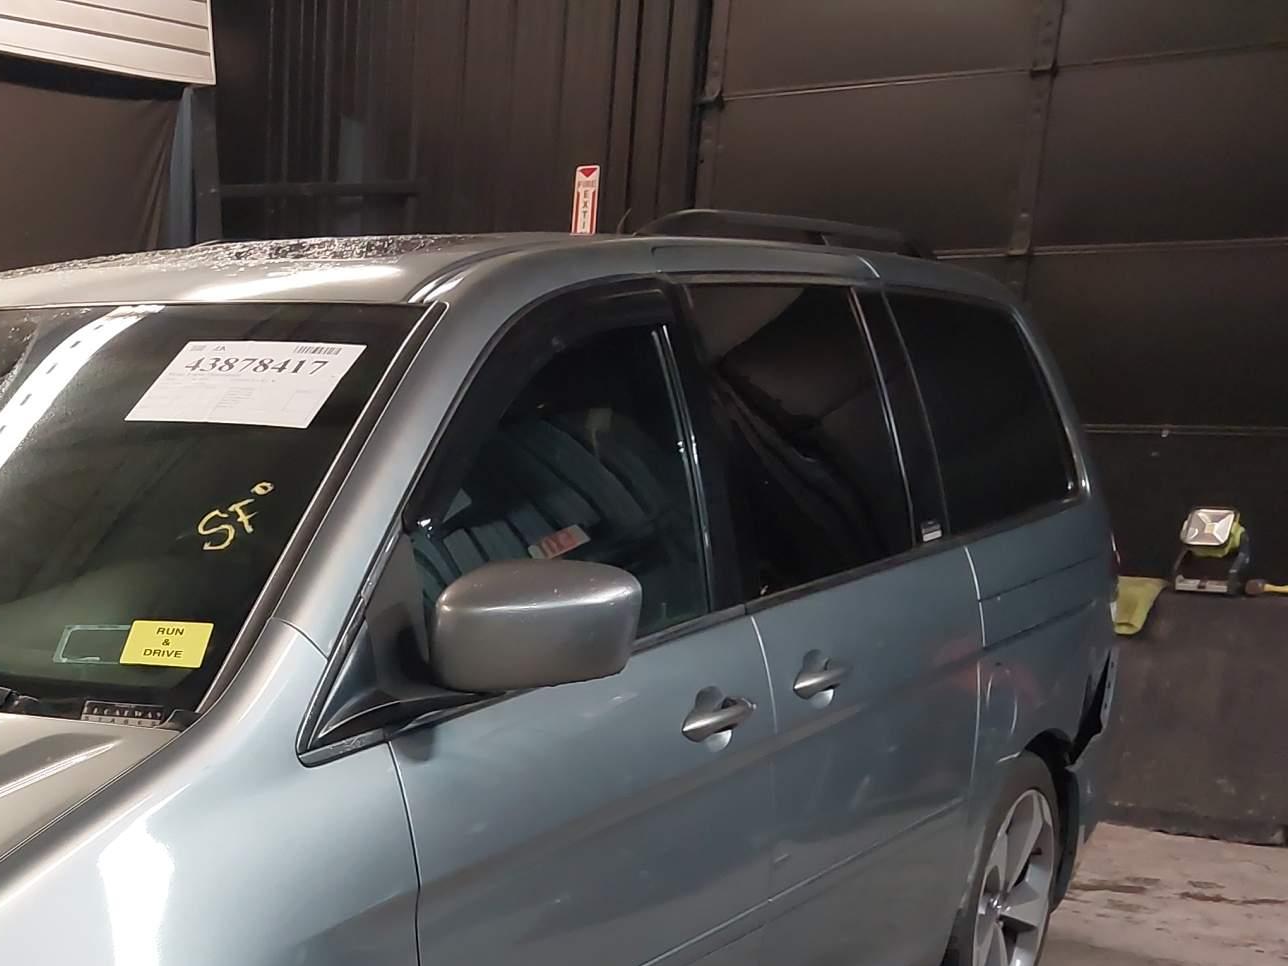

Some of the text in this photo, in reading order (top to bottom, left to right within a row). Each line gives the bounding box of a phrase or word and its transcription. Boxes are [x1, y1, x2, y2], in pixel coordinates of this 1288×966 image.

[184, 356, 329, 375] 43878417
[156, 627, 185, 636] RUN
[161, 638, 171, 647] &
[143, 648, 184, 659] DRIVE
